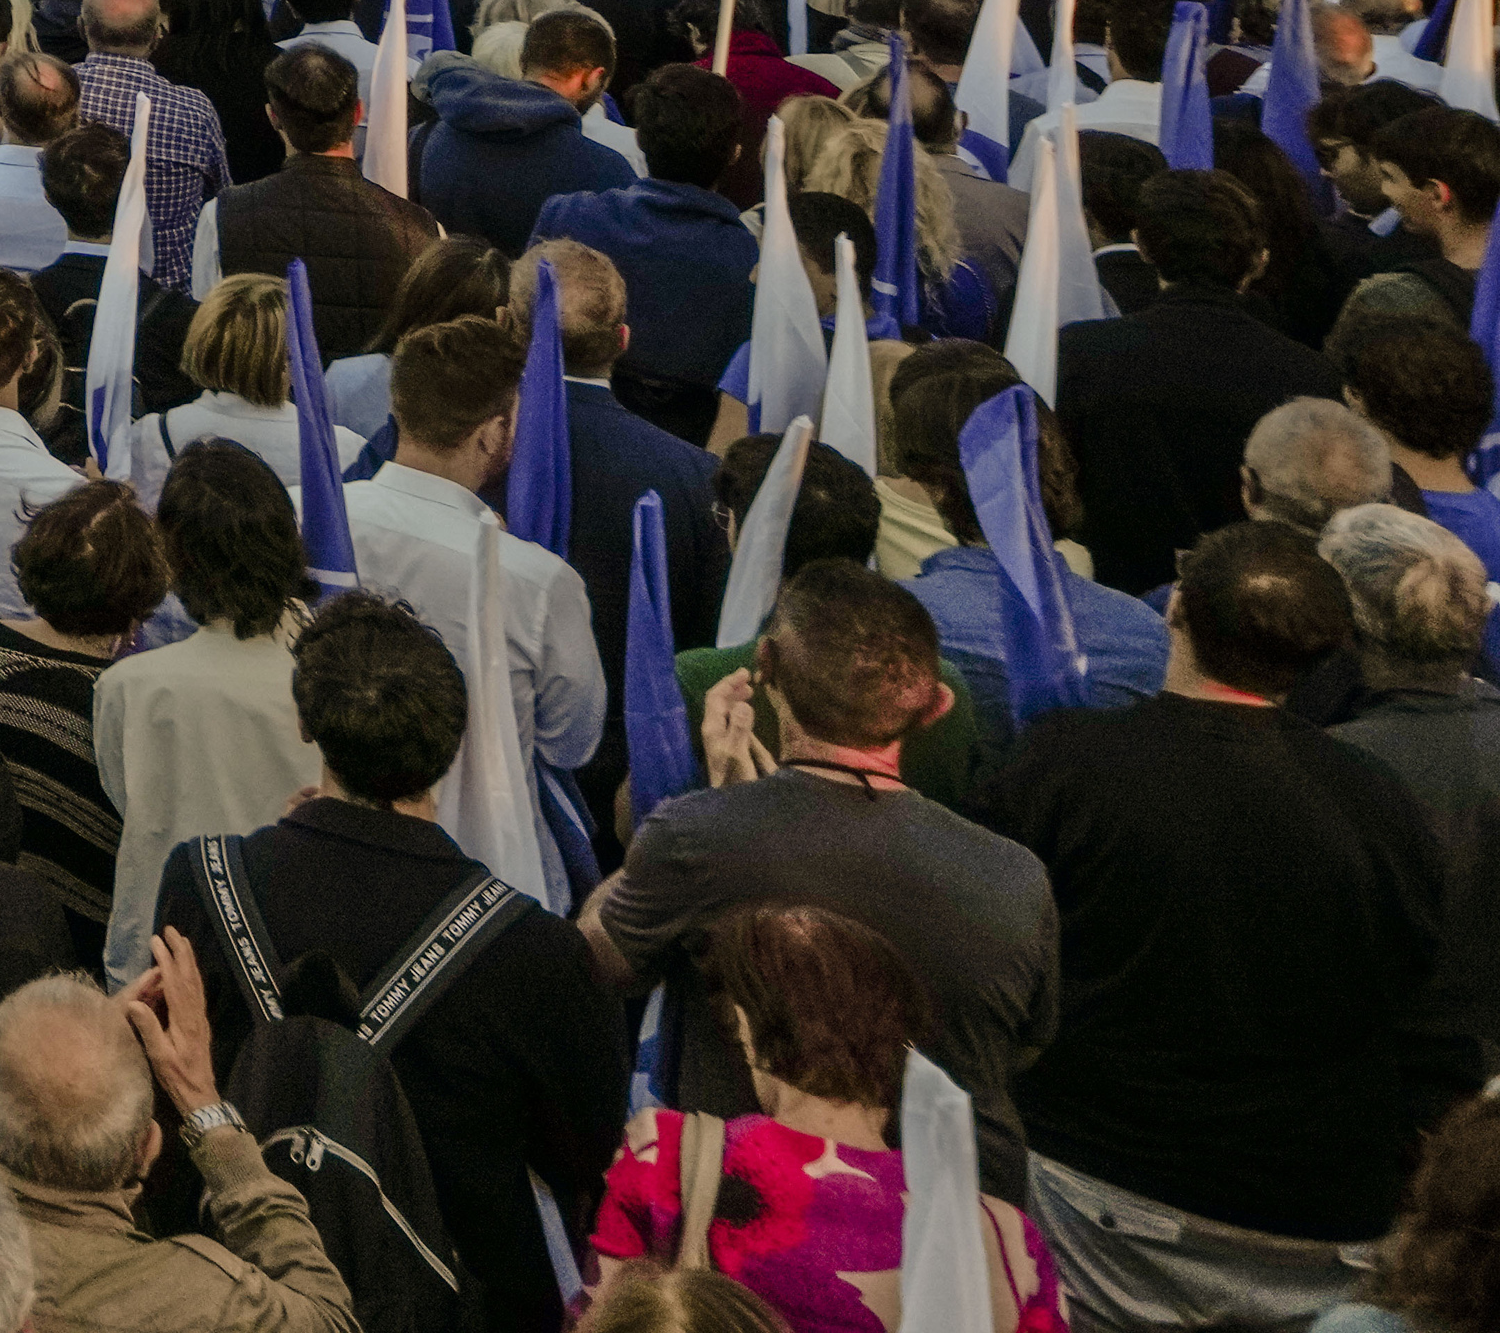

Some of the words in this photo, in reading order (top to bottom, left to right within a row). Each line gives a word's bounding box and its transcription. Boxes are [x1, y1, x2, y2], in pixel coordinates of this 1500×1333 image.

[369, 977, 411, 1024] TOMMY
[409, 941, 446, 983] JEANS
[442, 899, 484, 944] TOMMY
